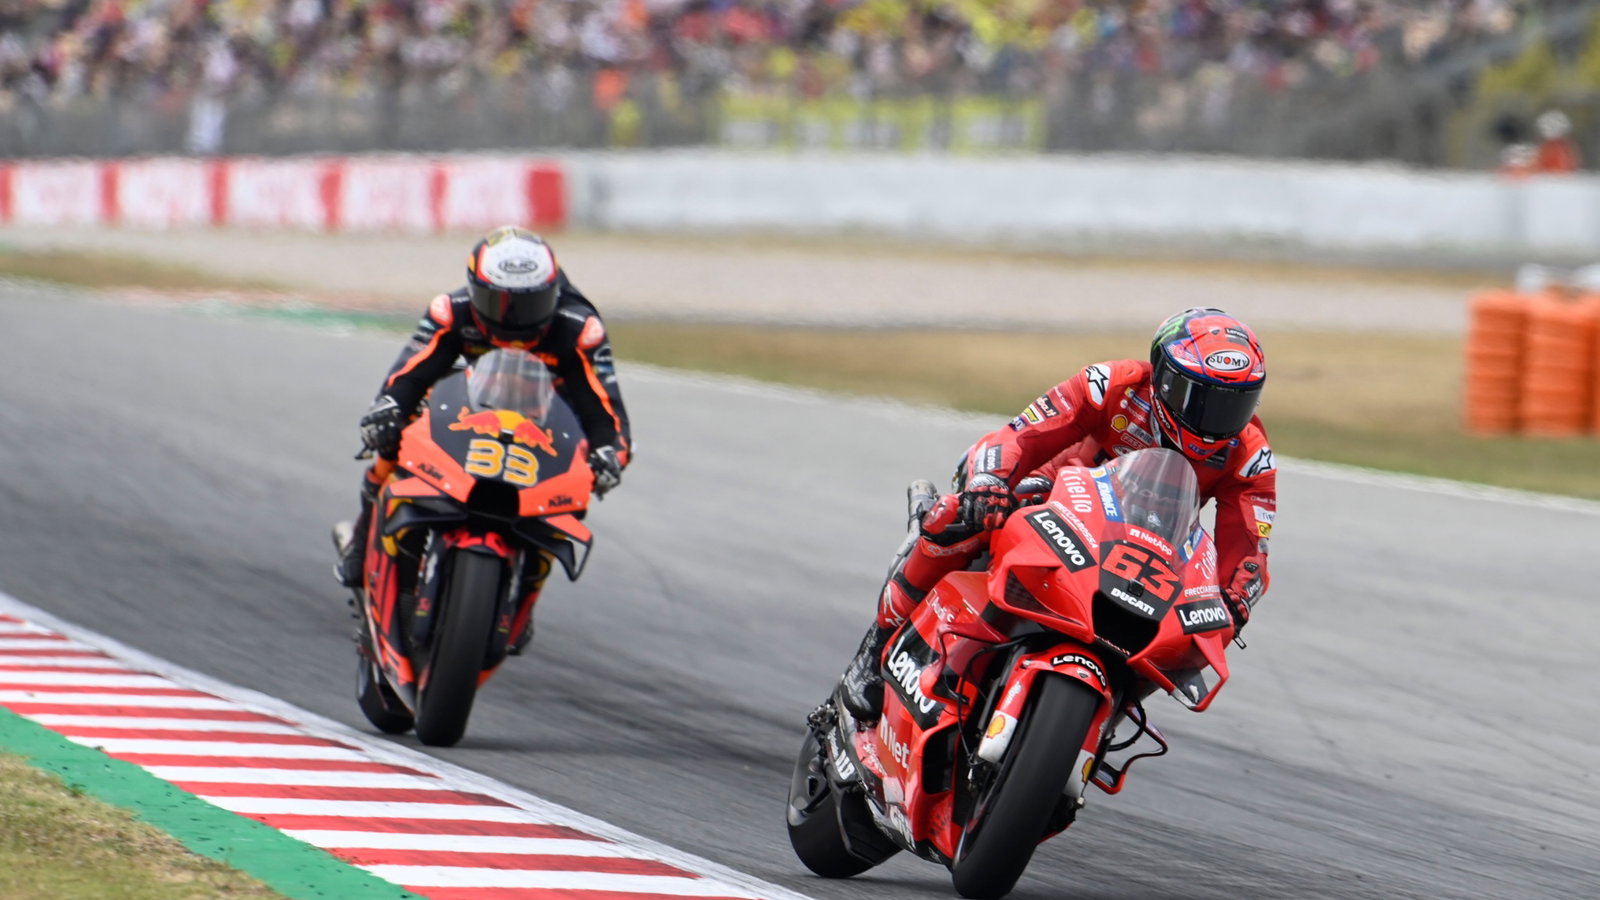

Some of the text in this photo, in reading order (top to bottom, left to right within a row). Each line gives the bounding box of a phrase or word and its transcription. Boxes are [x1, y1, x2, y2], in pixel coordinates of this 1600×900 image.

[1209, 354, 1248, 367] SUOMY
[417, 462, 444, 481] KTM
[465, 438, 539, 487] 33
[548, 495, 573, 508] KTM
[1033, 512, 1086, 566] Lenovo
[1140, 531, 1173, 556] NetApp
[1102, 543, 1180, 602] 63
[1110, 587, 1155, 616] DUCATI
[1179, 605, 1226, 627] Lenovo
[1053, 655, 1106, 687] Lenovo
